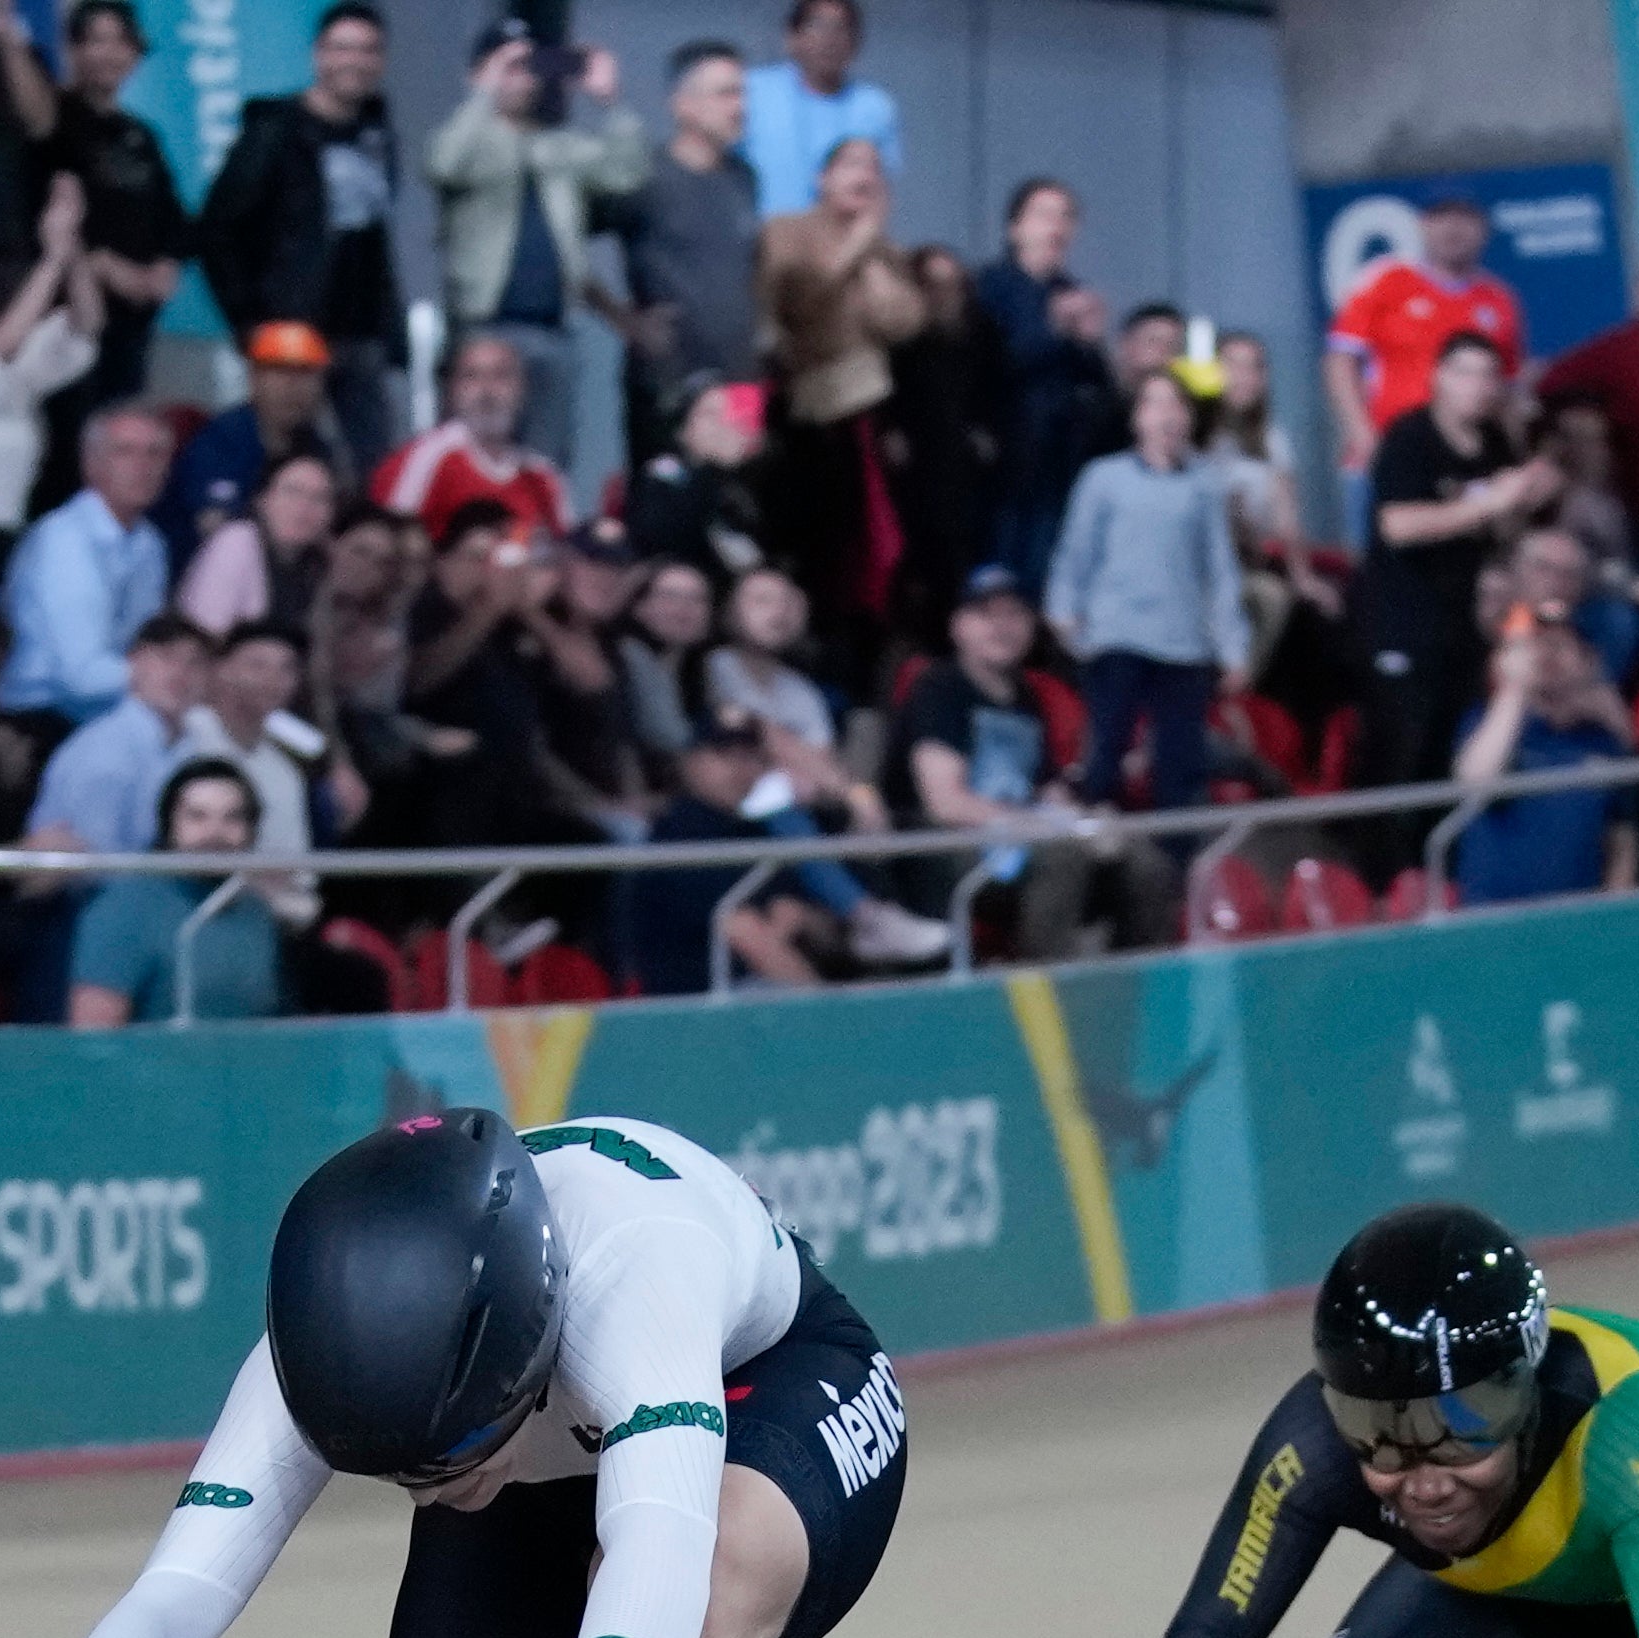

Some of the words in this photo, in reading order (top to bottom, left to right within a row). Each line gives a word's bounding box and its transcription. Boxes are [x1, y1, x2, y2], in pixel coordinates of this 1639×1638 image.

[863, 1098, 1000, 1260] 2023
[816, 1351, 906, 1499] México
[1217, 1442, 1306, 1616] JAMAICA
